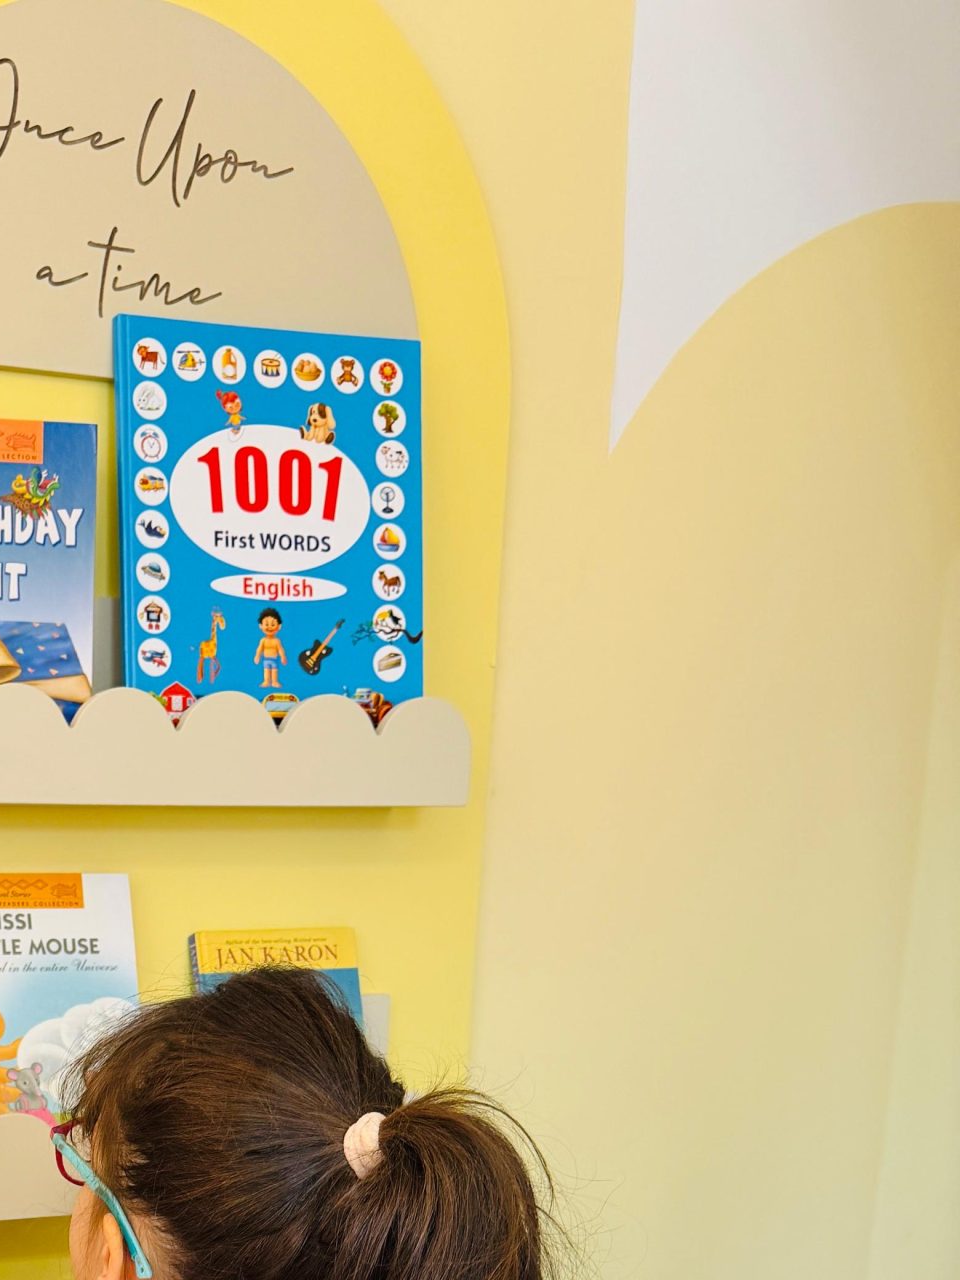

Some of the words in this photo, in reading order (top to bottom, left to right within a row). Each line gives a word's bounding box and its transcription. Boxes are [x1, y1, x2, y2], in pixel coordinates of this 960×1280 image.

[136, 89, 294, 208] Upon
[36, 265, 88, 286] a
[87, 227, 222, 318] time
[197, 445, 343, 522] 1001
[213, 530, 255, 550] First
[259, 532, 331, 553] WORDS
[242, 576, 314, 601] English
[28, 937, 100, 955] MOUSE
[215, 946, 253, 969] JAN
[262, 944, 338, 964] KARON
[8, 963, 19, 973] in
[22, 961, 38, 973] the
[39, 961, 68, 973] entire
[72, 958, 119, 973] Universe
